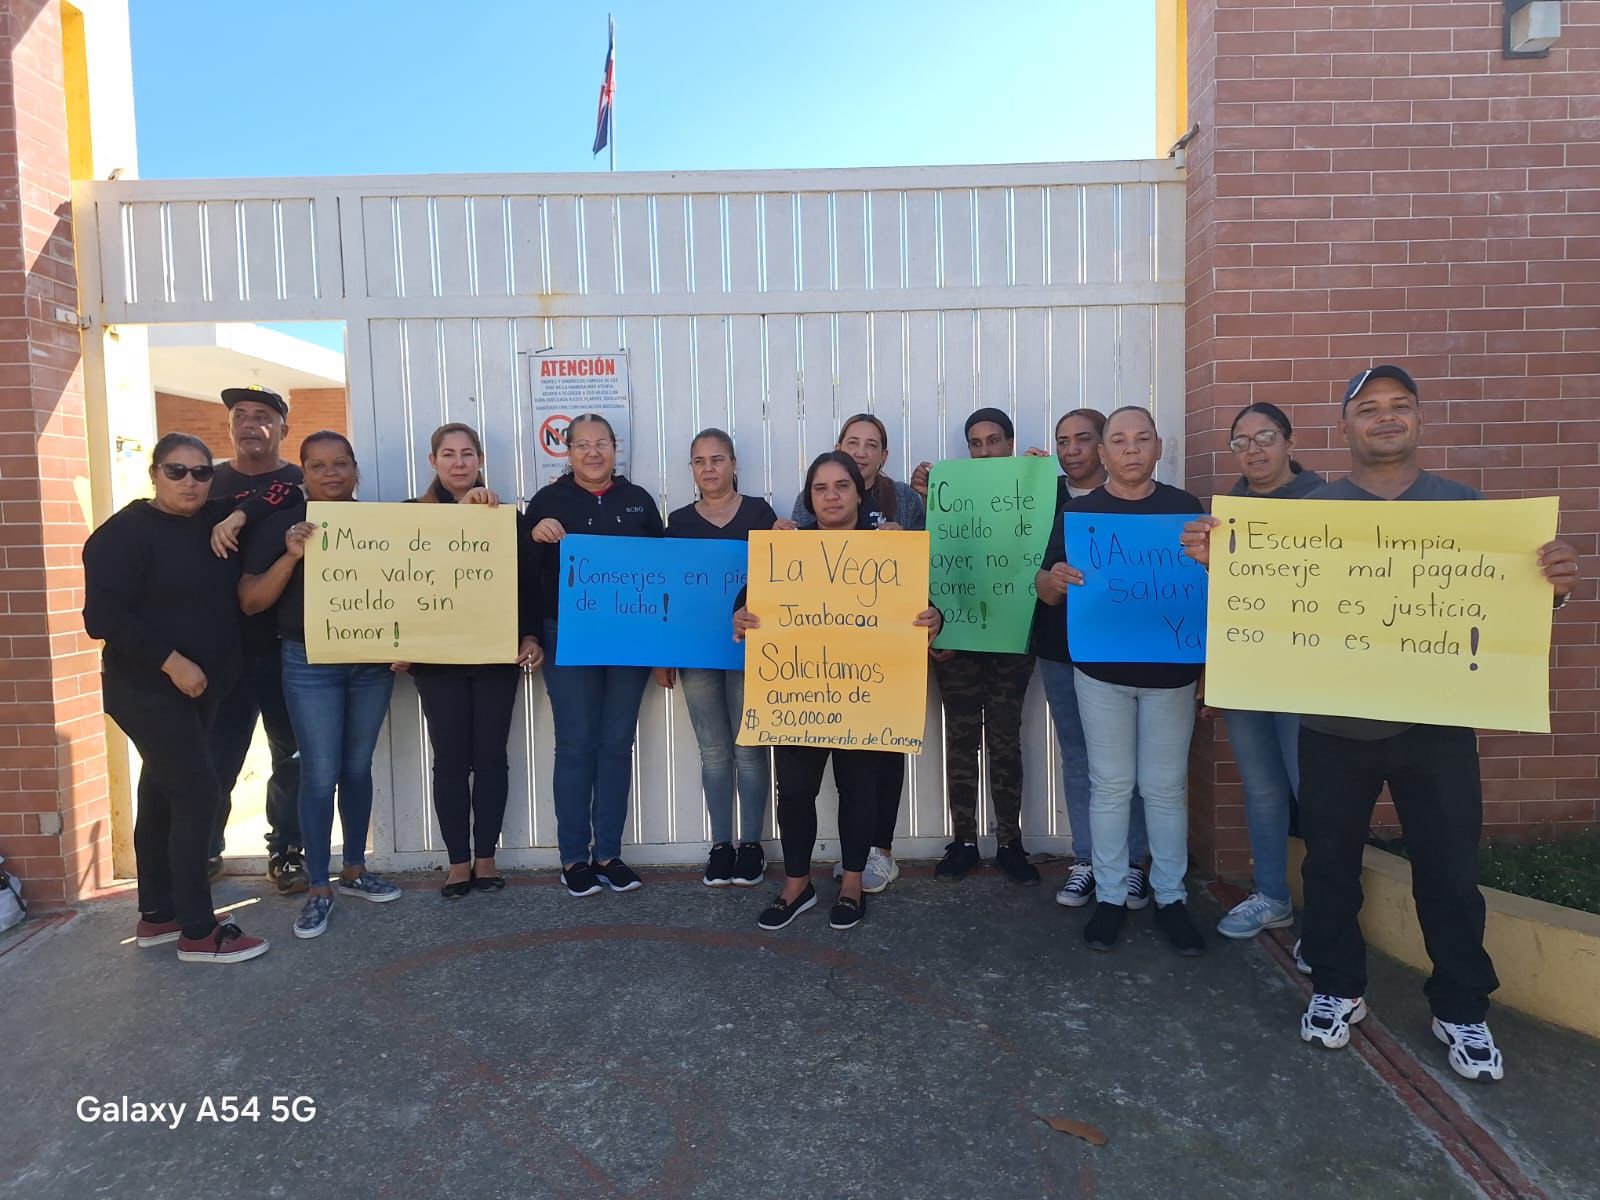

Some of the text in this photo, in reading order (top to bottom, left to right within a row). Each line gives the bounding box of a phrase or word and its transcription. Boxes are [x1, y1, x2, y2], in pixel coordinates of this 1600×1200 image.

[540, 356, 615, 377] ATENCIÓN
[928, 479, 1036, 513] ¡Con este
[321, 521, 490, 552] ¡Mano de obra
[938, 514, 1033, 540] sueldo de
[1228, 517, 1344, 554] ¡Escuela
[767, 542, 804, 583] La
[1088, 526, 1198, 570] ¡Aume
[321, 557, 495, 589] con valor, pero
[567, 555, 748, 596] ¡Conserjes en pie
[930, 553, 1043, 576] ayer, no se
[1228, 554, 1505, 590] conserje mal pagada,
[329, 588, 454, 613] sueldo sin
[576, 589, 598, 612] de
[929, 581, 976, 596] come
[993, 582, 1015, 596] en
[1108, 570, 1205, 604] Salari
[943, 601, 987, 630] 026!
[1227, 592, 1487, 628] eso no es justicia,
[1162, 615, 1202, 651] Ya
[1226, 626, 1265, 643] eso
[1292, 631, 1320, 648] no
[1344, 633, 1371, 651] es
[758, 642, 885, 684] Solicitamos
[766, 682, 872, 705] aumento de
[744, 708, 842, 731] $ 30,000.00
[758, 729, 858, 746] Departamento
[861, 732, 879, 746] de
